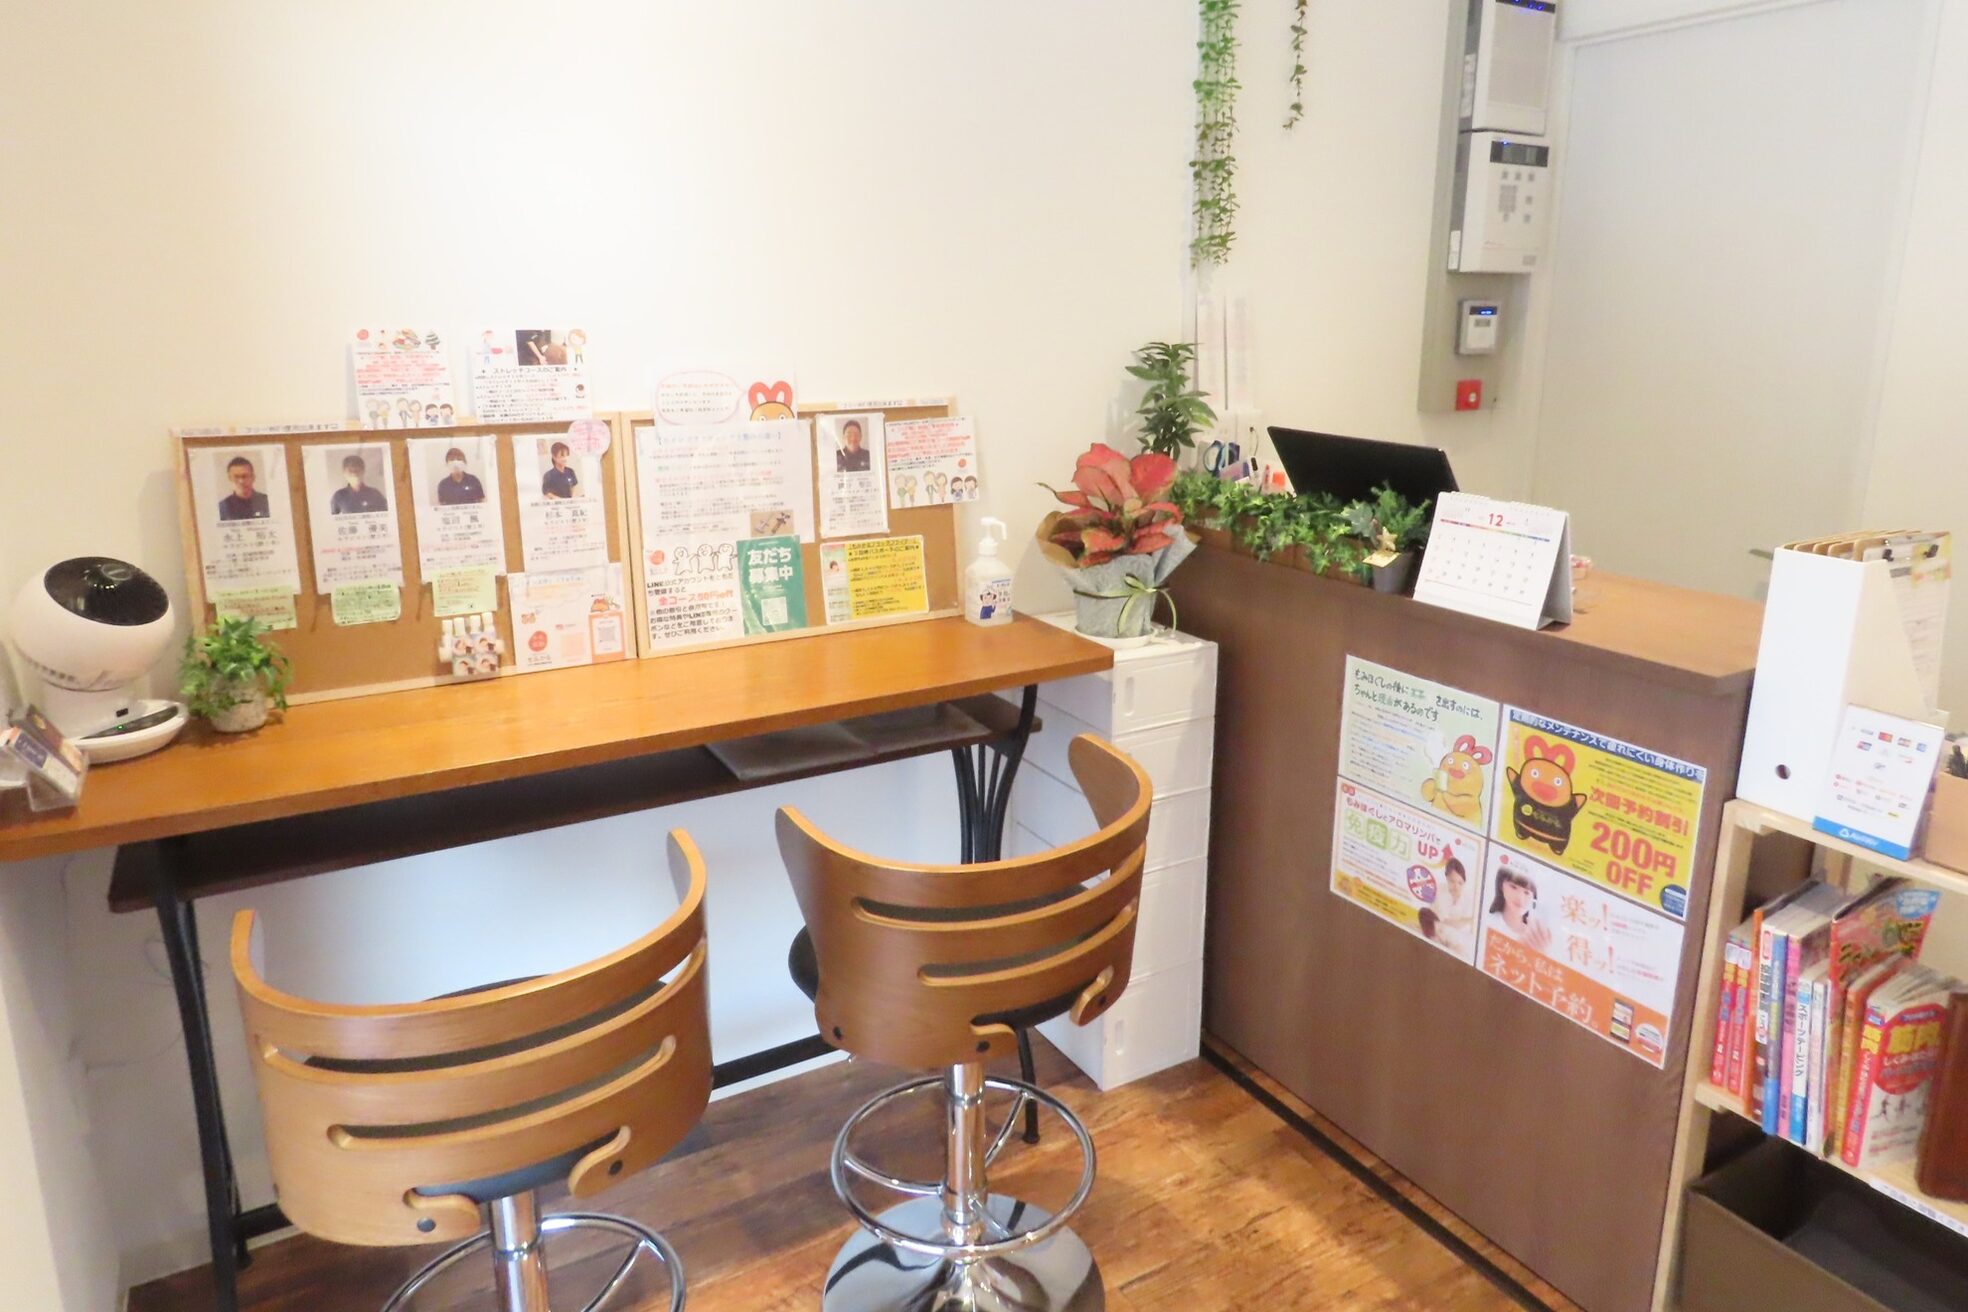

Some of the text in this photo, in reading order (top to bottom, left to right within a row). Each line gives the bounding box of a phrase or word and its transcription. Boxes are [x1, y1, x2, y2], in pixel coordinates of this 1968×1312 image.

[1488, 513, 1504, 527] 12
[748, 547, 792, 566] 友だち
[749, 566, 793, 584] 募集中
[1418, 840, 1439, 859] UP
[1589, 821, 1677, 879] 200円
[1606, 860, 1654, 896] OFF
